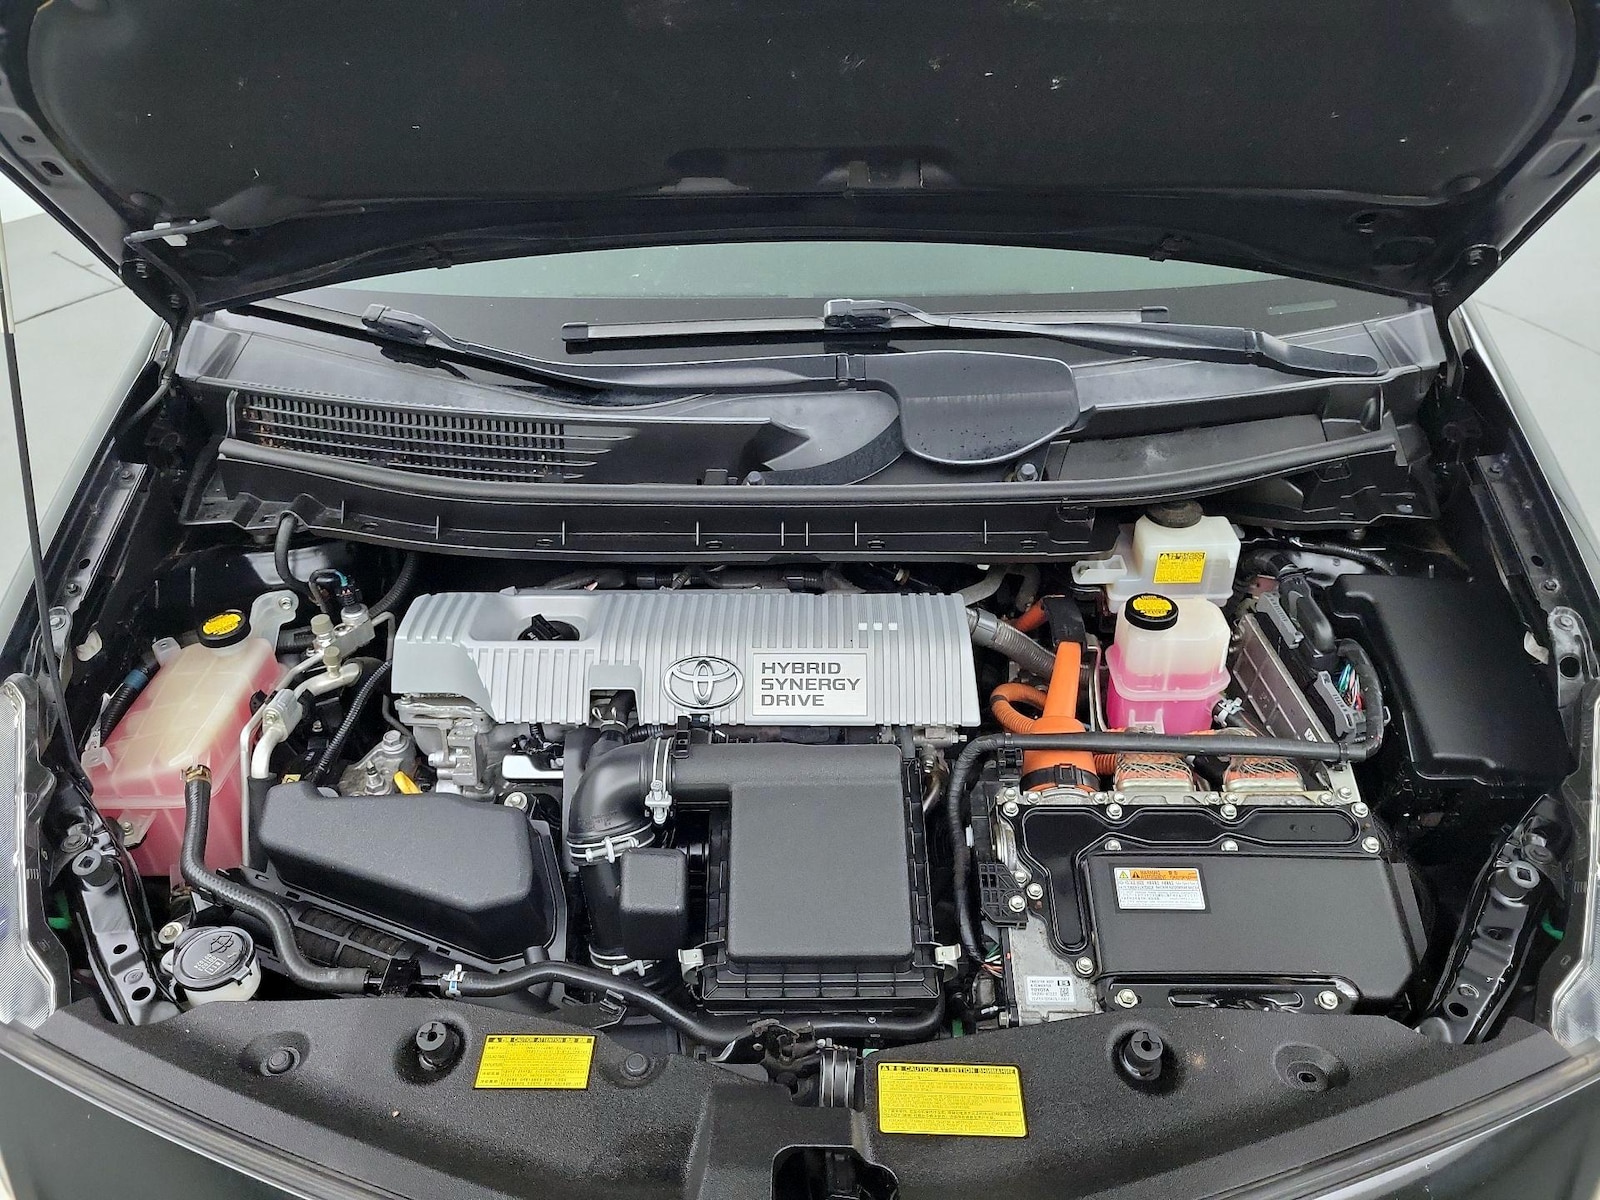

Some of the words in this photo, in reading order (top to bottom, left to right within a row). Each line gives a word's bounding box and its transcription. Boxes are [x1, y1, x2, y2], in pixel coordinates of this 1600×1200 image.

[761, 662, 841, 675] HYBRID
[761, 678, 861, 691] SYNERGY
[761, 694, 825, 707] DRIVE
